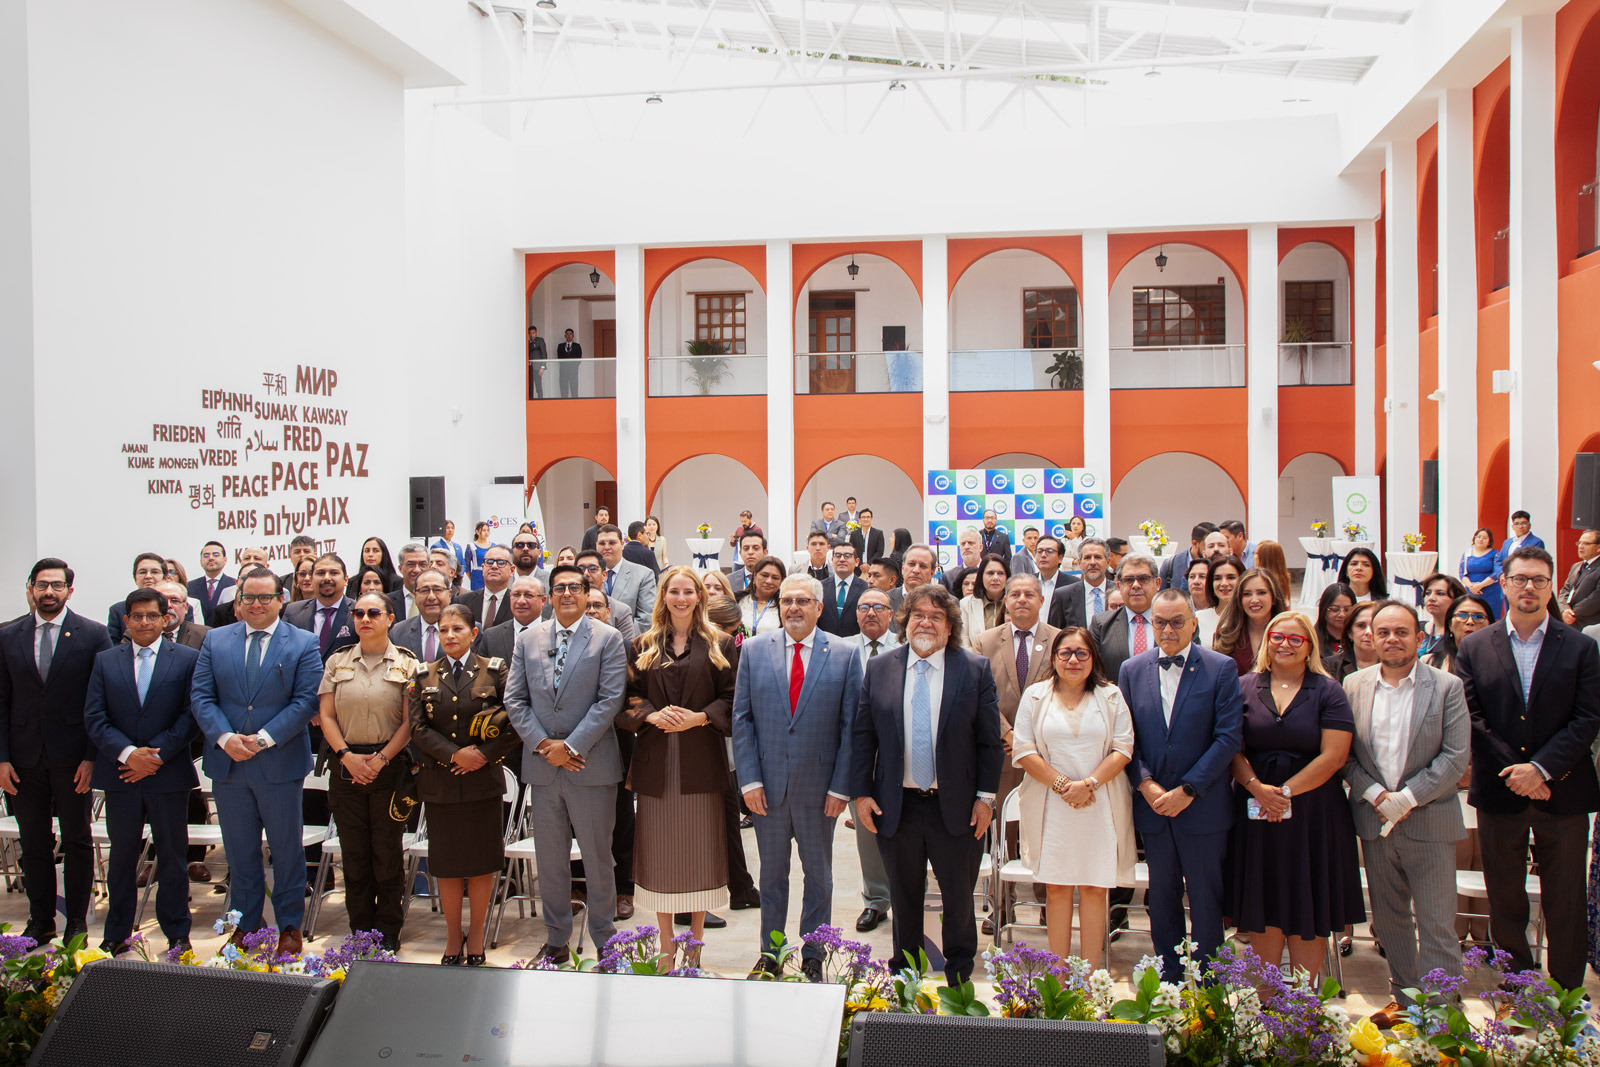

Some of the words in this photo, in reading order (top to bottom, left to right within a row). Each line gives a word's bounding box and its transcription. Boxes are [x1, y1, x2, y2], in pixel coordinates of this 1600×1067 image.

[263, 373, 287, 396] 平和
[296, 365, 337, 396] МИР
[255, 401, 298, 422] SUMAK
[303, 406, 348, 426] KAWSAY
[153, 424, 205, 443] FRIEDEN
[217, 415, 242, 439] शांति
[284, 425, 322, 452] FRED
[121, 443, 148, 453] AMANI
[199, 449, 237, 466] VREDE
[245, 430, 279, 463] سلام
[128, 457, 154, 469] KUME
[159, 457, 198, 469] MONGEN
[326, 442, 369, 477] PAZ
[148, 480, 183, 494] KINTA
[222, 475, 268, 498] PEACE
[272, 462, 318, 491] PACE
[189, 484, 216, 509] 평화
[264, 505, 305, 536] שלום
[307, 497, 349, 526] PAIX
[500, 517, 518, 525] CES
[314, 538, 337, 556] 平
